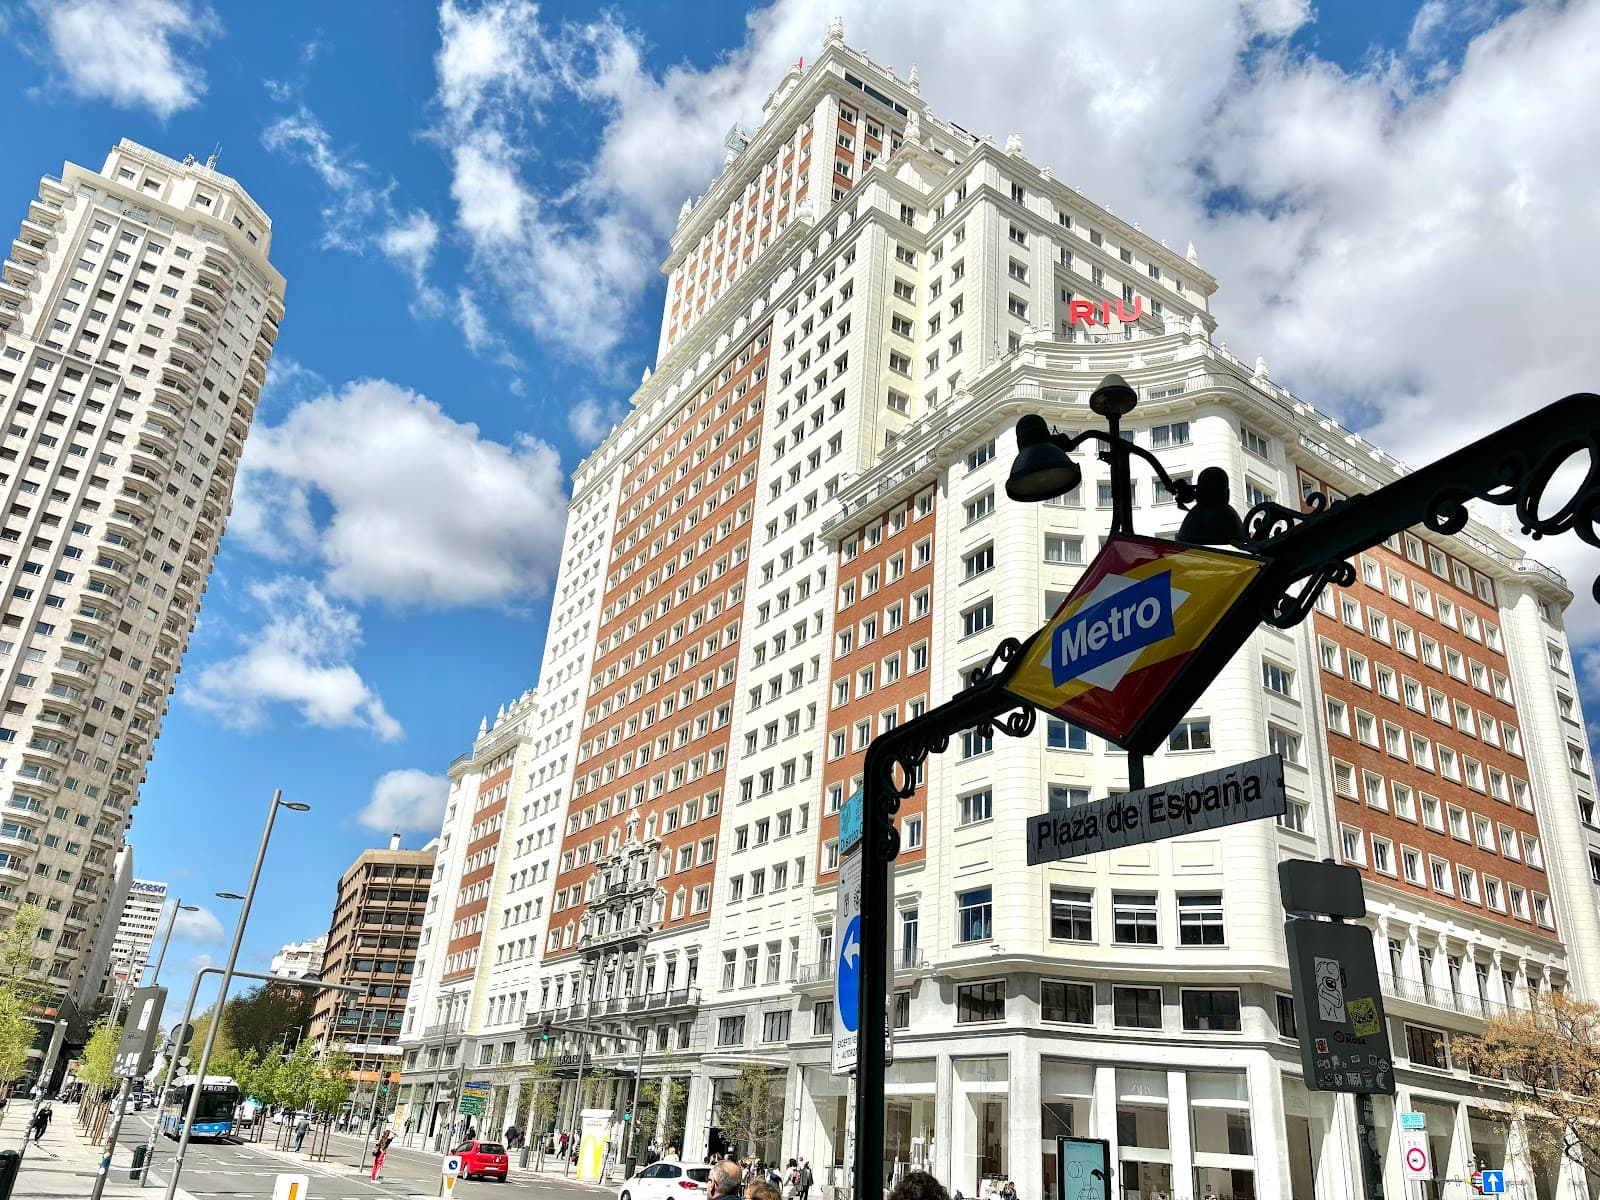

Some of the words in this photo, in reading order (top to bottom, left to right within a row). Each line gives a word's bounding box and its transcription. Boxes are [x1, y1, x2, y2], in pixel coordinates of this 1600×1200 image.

[1069, 295, 1143, 326] RIU
[1060, 595, 1162, 667] Metro
[1036, 811, 1100, 850] Plaza
[1107, 802, 1139, 834] de
[1148, 771, 1263, 824] España
